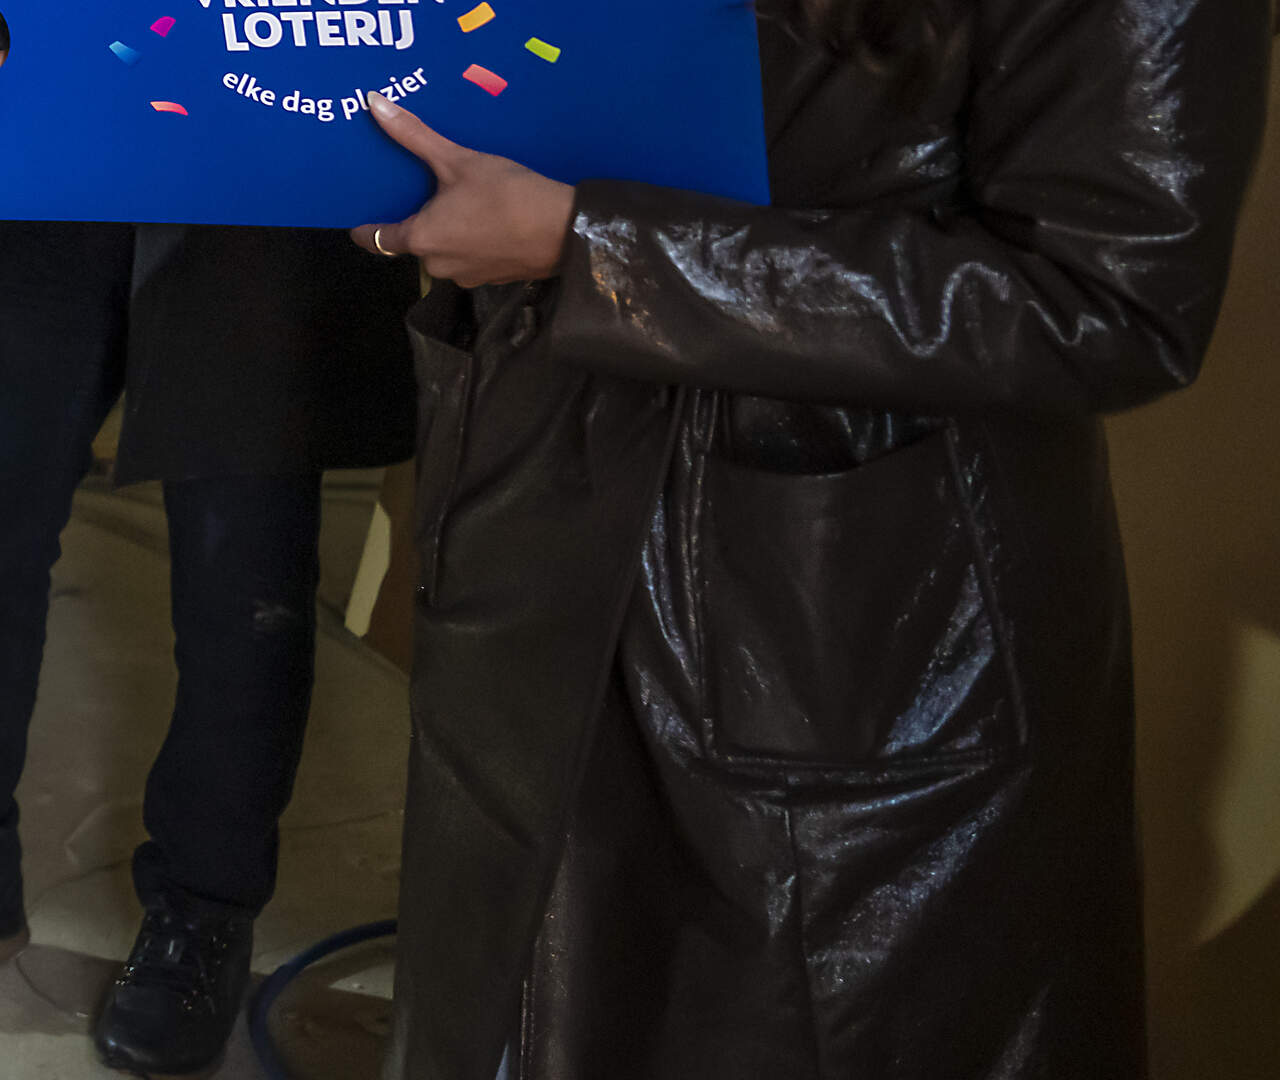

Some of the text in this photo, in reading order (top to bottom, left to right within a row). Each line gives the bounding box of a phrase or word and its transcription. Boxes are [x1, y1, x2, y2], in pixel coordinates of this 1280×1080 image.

[221, 9, 415, 52] LOTERIJ
[222, 67, 428, 122] elke dag plzier
